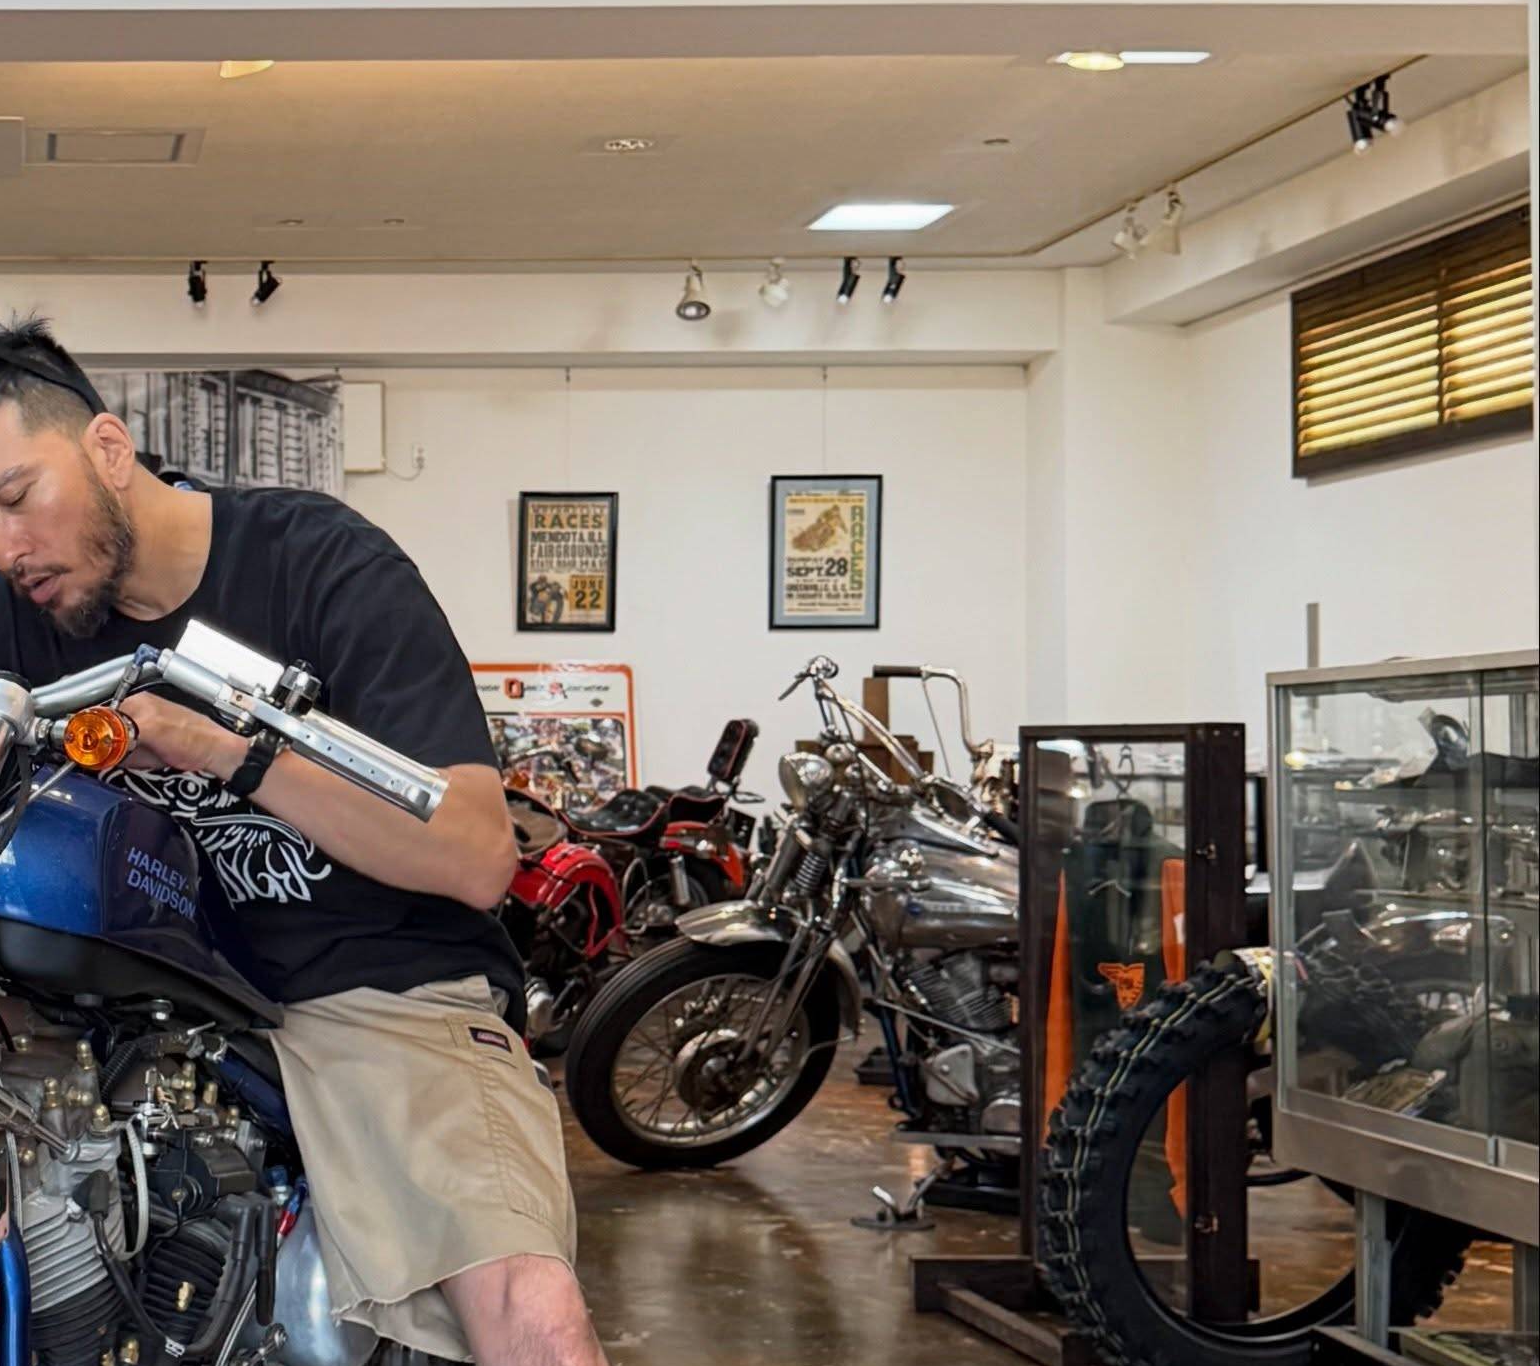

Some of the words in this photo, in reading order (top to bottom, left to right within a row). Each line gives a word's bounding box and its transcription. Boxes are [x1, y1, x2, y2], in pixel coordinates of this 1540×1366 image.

[534, 514, 603, 528] RACES
[530, 543, 607, 558] FAIRGROUNDS
[825, 556, 848, 577] 28
[572, 579, 604, 589] JUNE
[575, 590, 602, 610] 22
[127, 868, 197, 922] DAVIDSON
